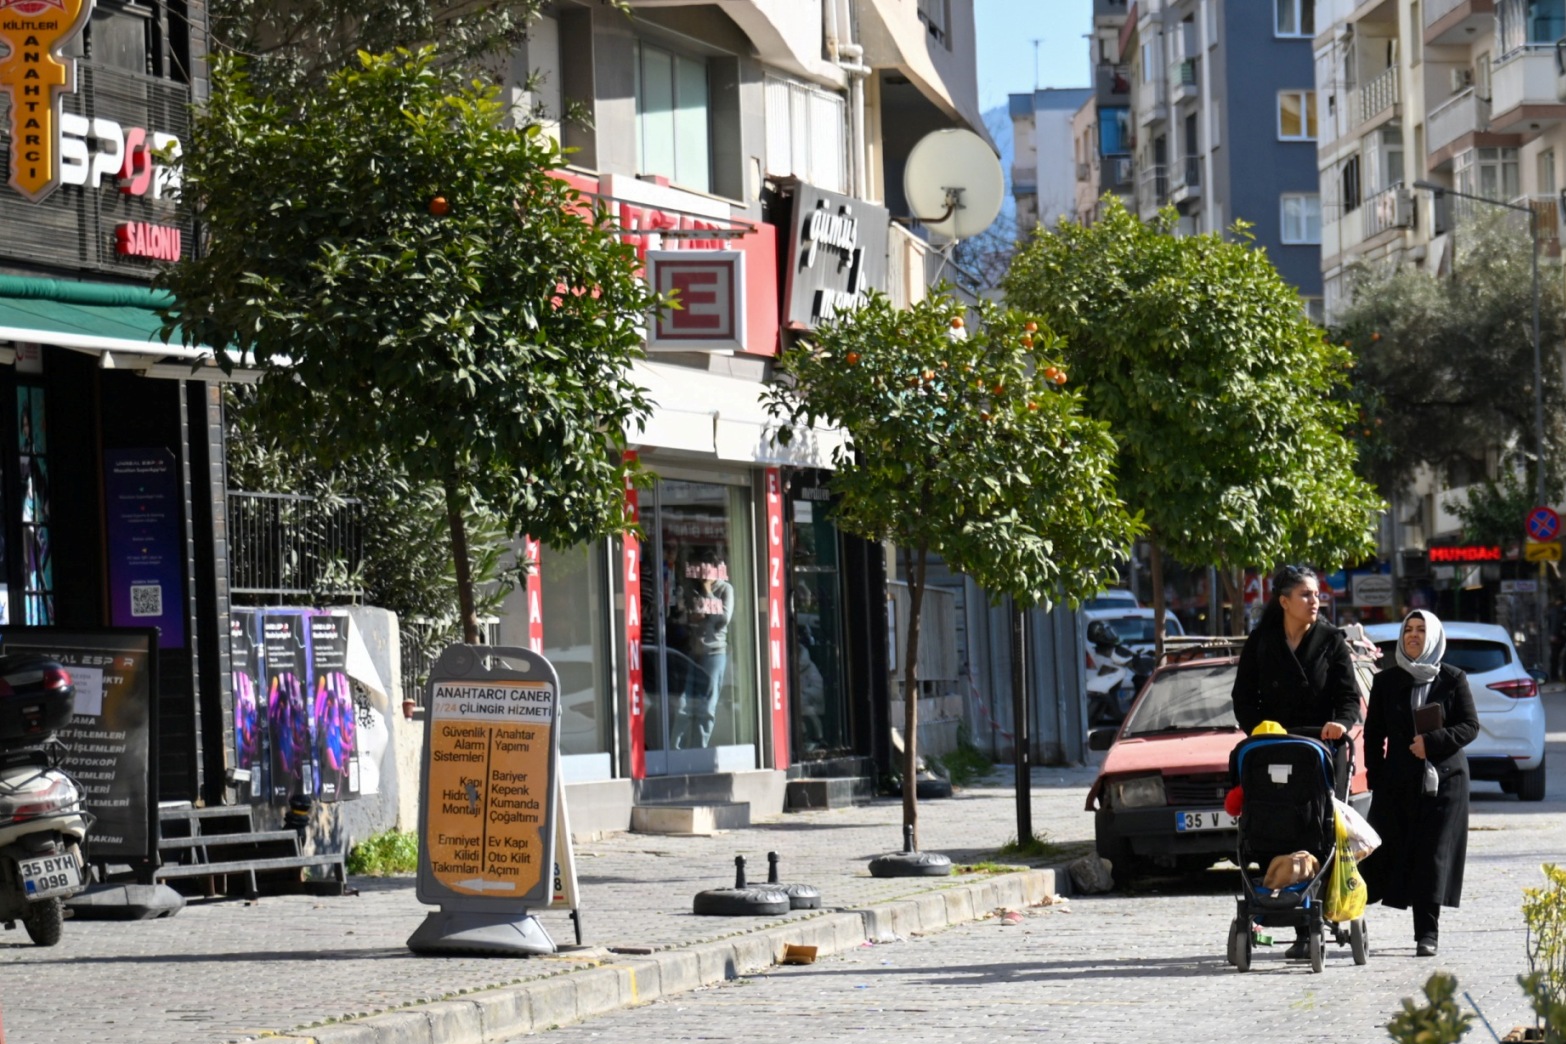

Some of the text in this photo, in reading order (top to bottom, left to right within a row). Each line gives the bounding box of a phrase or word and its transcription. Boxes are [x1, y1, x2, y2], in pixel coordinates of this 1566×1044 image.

[3, 20, 58, 31] KİLİTLERİ
[24, 36, 40, 179] ANAHTARCI
[124, 221, 182, 262] SALONU
[768, 474, 781, 710] ECZANE
[436, 687, 551, 702] ANAHTARCI CANER
[434, 703, 552, 717] 7/24 ÇİLİNGİR HİZMETİ
[74, 730, 126, 740] İŞLEMLERİ
[442, 726, 486, 738] Güvenlik
[495, 728, 535, 741] Anahtar
[74, 744, 126, 754] İŞLEMLERİ
[454, 739, 485, 750] Alarm
[495, 740, 529, 753] Yapımı
[65, 757, 117, 767] FOTOKOPİ
[433, 750, 484, 763] Sistemleri
[460, 777, 482, 788] Kapı
[492, 771, 528, 783] Bariyer
[491, 784, 529, 796] Kepenk
[442, 803, 481, 817] Montajı
[490, 798, 539, 810] Kumanda
[489, 810, 538, 824] Çoğaltımı
[1185, 813, 1202, 828] 35
[1212, 812, 1219, 826] V
[438, 834, 480, 848] Emniyet
[488, 837, 528, 850] Ev Kapı
[454, 850, 479, 861] Kilidi
[488, 852, 531, 864] Oto Kilit
[22, 856, 74, 877] 35 BYH
[432, 862, 479, 874] Takımları
[488, 865, 519, 877] Açımı
[39, 873, 69, 890] 098
